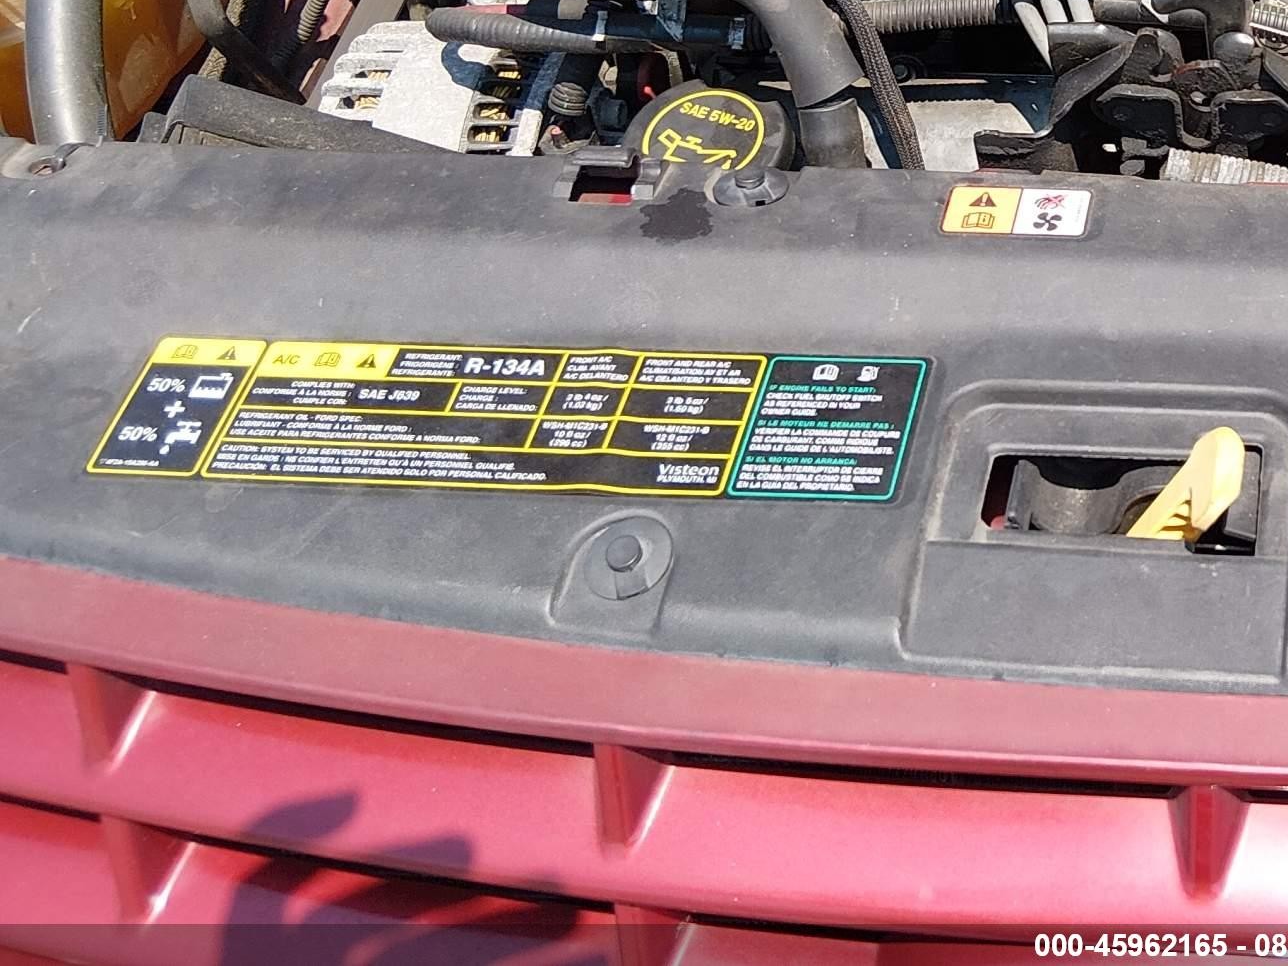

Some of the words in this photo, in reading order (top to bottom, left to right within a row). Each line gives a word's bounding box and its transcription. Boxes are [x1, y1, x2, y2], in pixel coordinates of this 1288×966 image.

[680, 102, 710, 118] SAE
[709, 110, 756, 132] 5W-20
[272, 355, 300, 365] A/C
[464, 357, 545, 376] R-134A
[391, 368, 455, 376] REFRIGERANTE:
[580, 373, 629, 381] DELANTERO
[146, 378, 186, 393] 50%
[712, 377, 751, 385] TRASERO
[252, 387, 298, 395] CONFORME
[358, 389, 388, 400] SAE
[388, 390, 421, 401] J639
[462, 386, 498, 394] CHARGE
[499, 387, 528, 395] LEVEL:
[455, 402, 483, 410] CARGA
[498, 404, 538, 412] LLENADO:
[776, 401, 828, 409] REFERENCED
[238, 411, 294, 420] REFRIGERANT
[295, 413, 309, 421] OIL
[234, 420, 282, 428] LUBRIFIANT
[286, 422, 332, 430] CONFORME
[117, 425, 158, 442] 50%
[301, 431, 367, 439] REFRIGERANTES
[368, 433, 415, 442] CONFORME
[455, 436, 481, 444] FORD:
[791, 428, 800, 436] LA
[802, 429, 848, 437] COMMANDE
[849, 430, 861, 438] DE
[862, 430, 900, 439] COUPURE
[815, 437, 845, 445] COMME
[221, 444, 260, 452] CAUTION:
[308, 447, 321, 455] BE
[322, 448, 361, 456] SERVICED
[374, 450, 419, 458] QUALIFIED
[772, 444, 783, 452] LE
[216, 453, 236, 461] MISE
[300, 456, 334, 464] CONFIER
[335, 457, 387, 466] L'ENTRETIEN
[424, 460, 474, 469] PERSONNEL
[270, 463, 282, 471] EL
[283, 464, 318, 472] SISTEMA
[343, 466, 360, 474] SER
[361, 467, 403, 475] ATENDIDO
[404, 468, 428, 476] SOLO
[448, 470, 492, 478] PERSONAL
[495, 472, 547, 480] CALIFICADO.
[659, 464, 719, 475] Visteon
[742, 464, 772, 472] REVISE
[783, 465, 840, 474] INTERRUPTOR
[840, 466, 852, 474] DE
[853, 467, 883, 475] CIERRE
[740, 472, 755, 480] DEL
[756, 473, 814, 482] COMBUSTIBLE
[852, 476, 880, 484] INDICA
[782, 482, 798, 490] DEL
[800, 482, 855, 491] PROPIETARIO.
